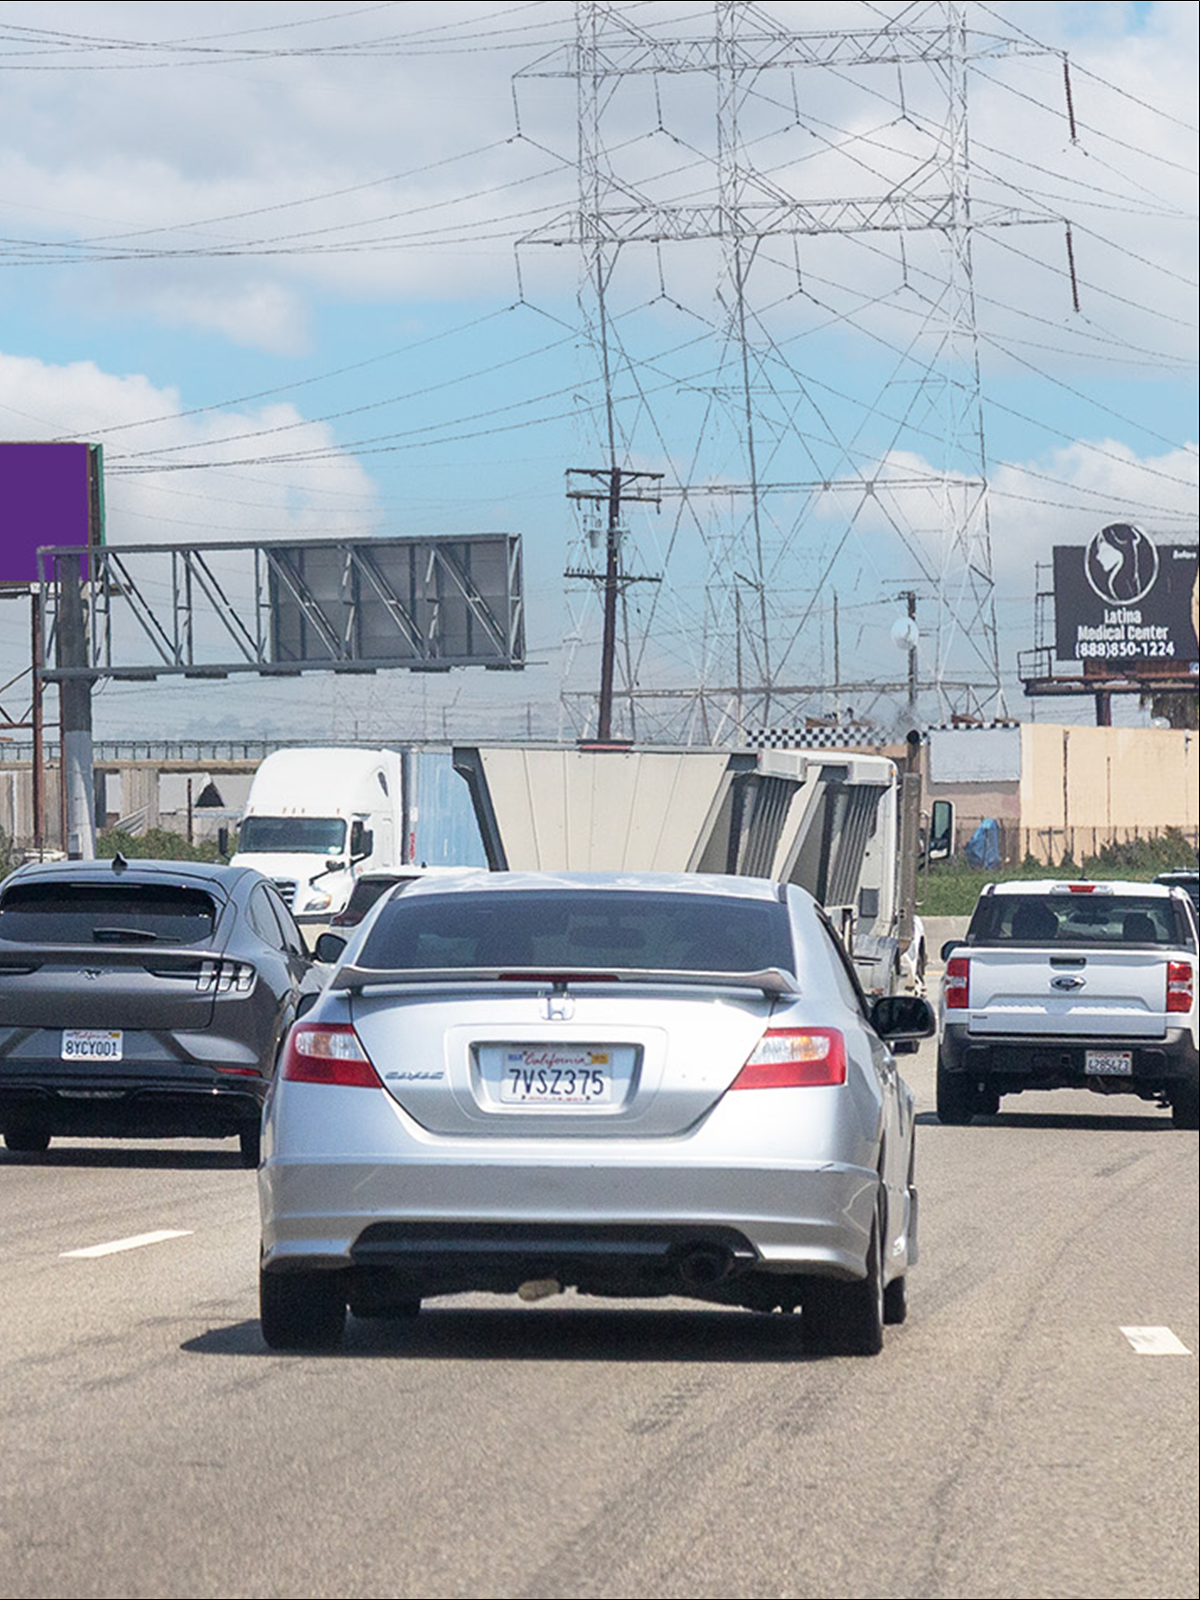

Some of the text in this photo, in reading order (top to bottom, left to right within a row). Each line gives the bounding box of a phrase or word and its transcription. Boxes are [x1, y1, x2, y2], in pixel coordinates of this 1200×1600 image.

[1103, 607, 1142, 624] Latina
[1077, 625, 1169, 641] Medical Center
[1075, 641, 1175, 659] (888)850-1224
[65, 1040, 118, 1056] 8YCY001
[523, 1052, 587, 1068] California
[508, 1068, 606, 1097] 7VSZ375
